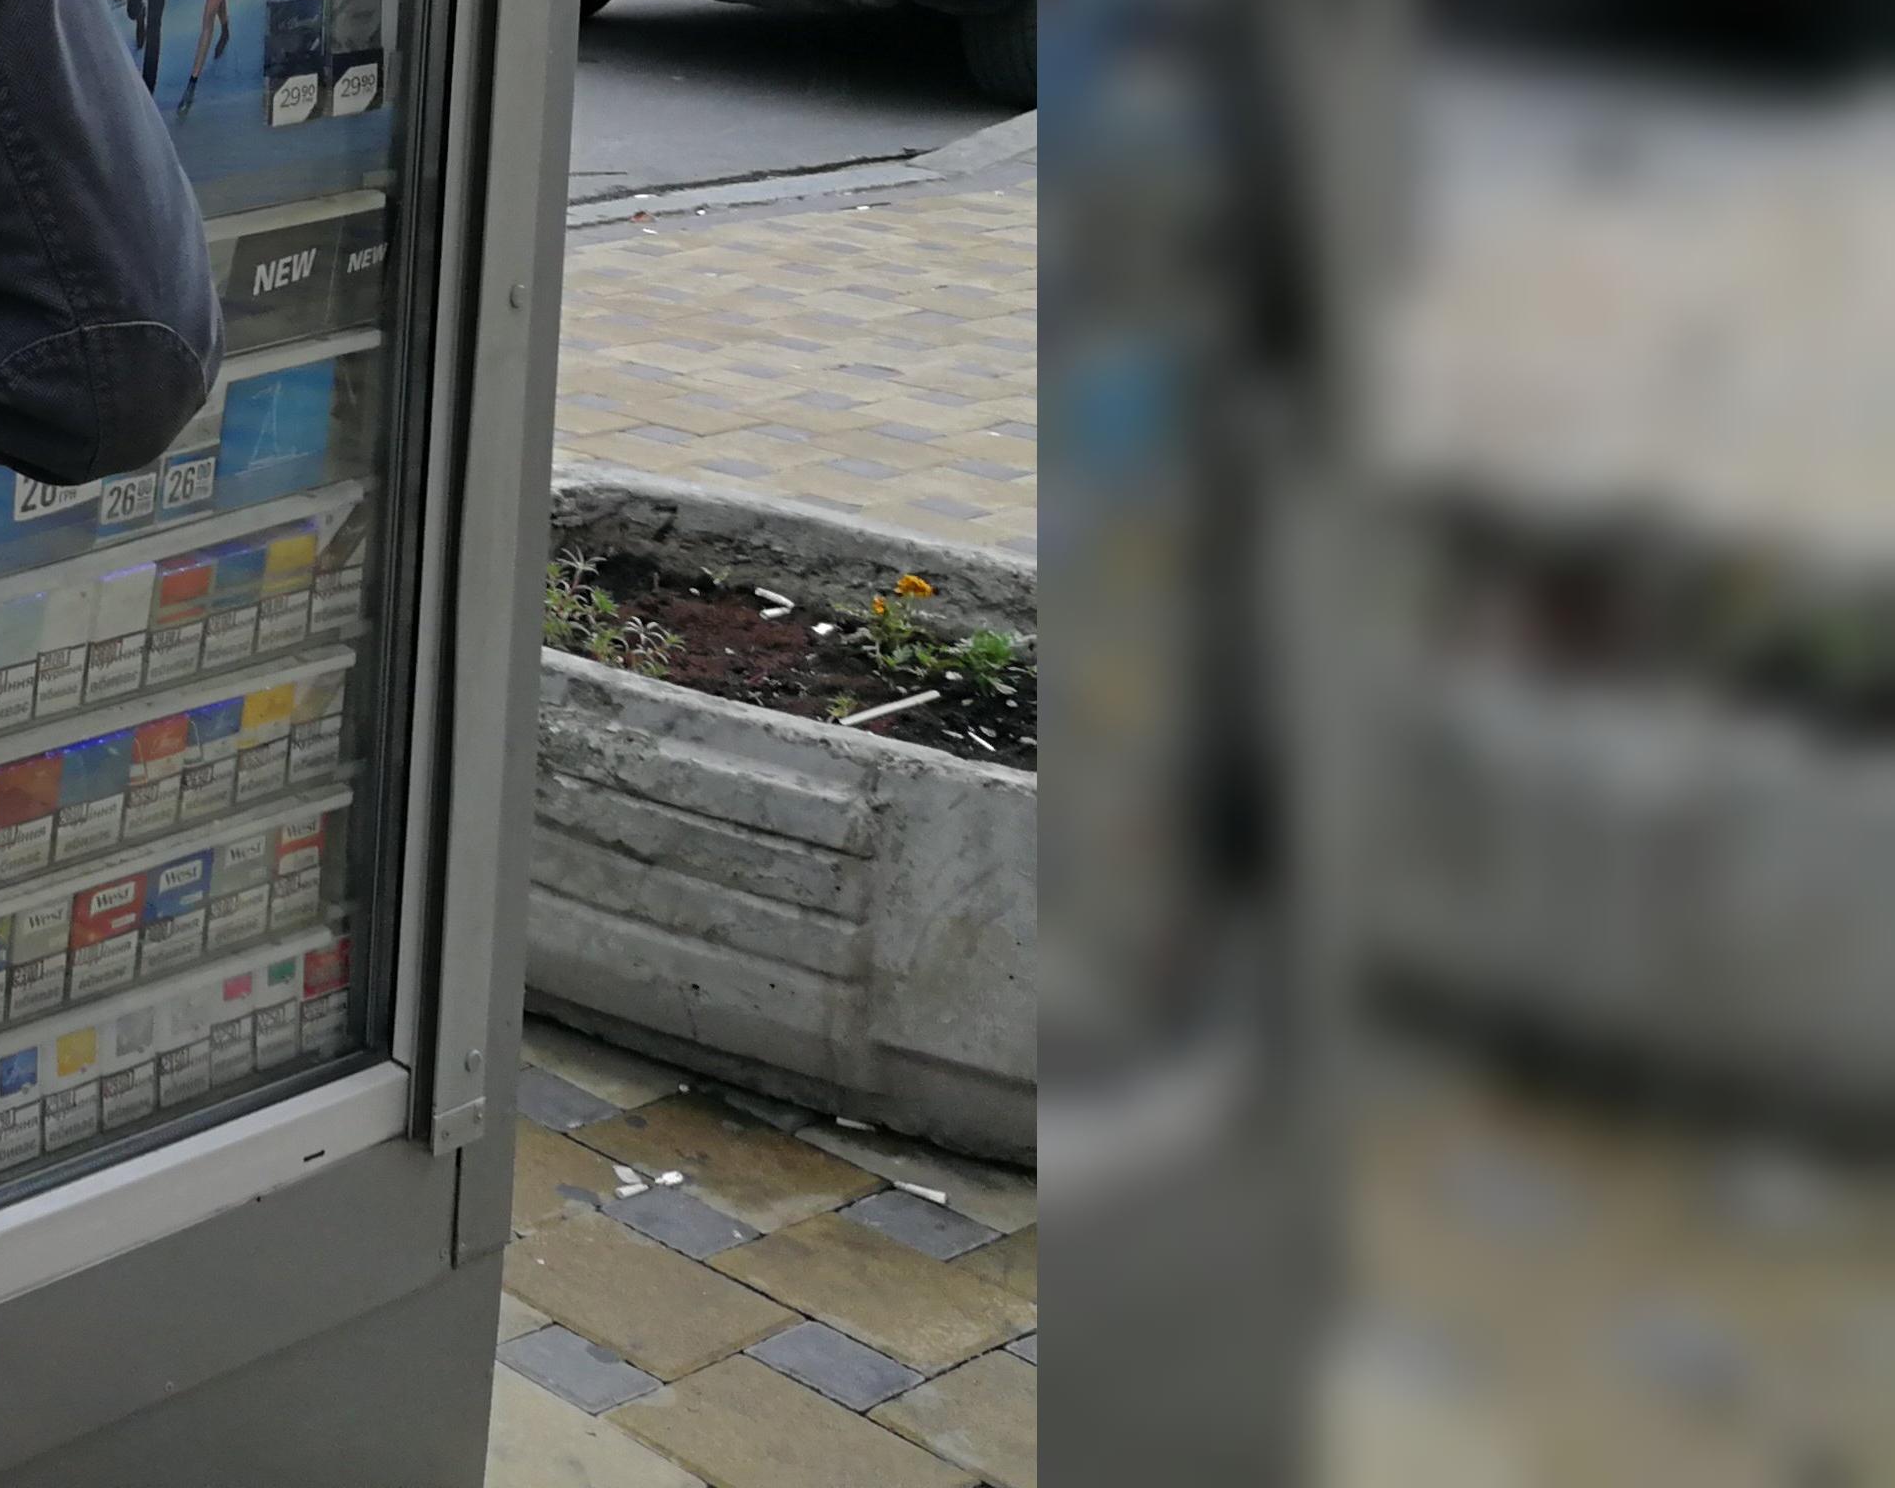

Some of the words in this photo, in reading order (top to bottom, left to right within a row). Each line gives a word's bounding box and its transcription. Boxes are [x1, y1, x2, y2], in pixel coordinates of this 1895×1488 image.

[347, 242, 389, 274] NEW
[252, 248, 318, 296] NEW
[285, 814, 319, 839] West
[165, 861, 199, 886] West
[96, 883, 132, 909] West
